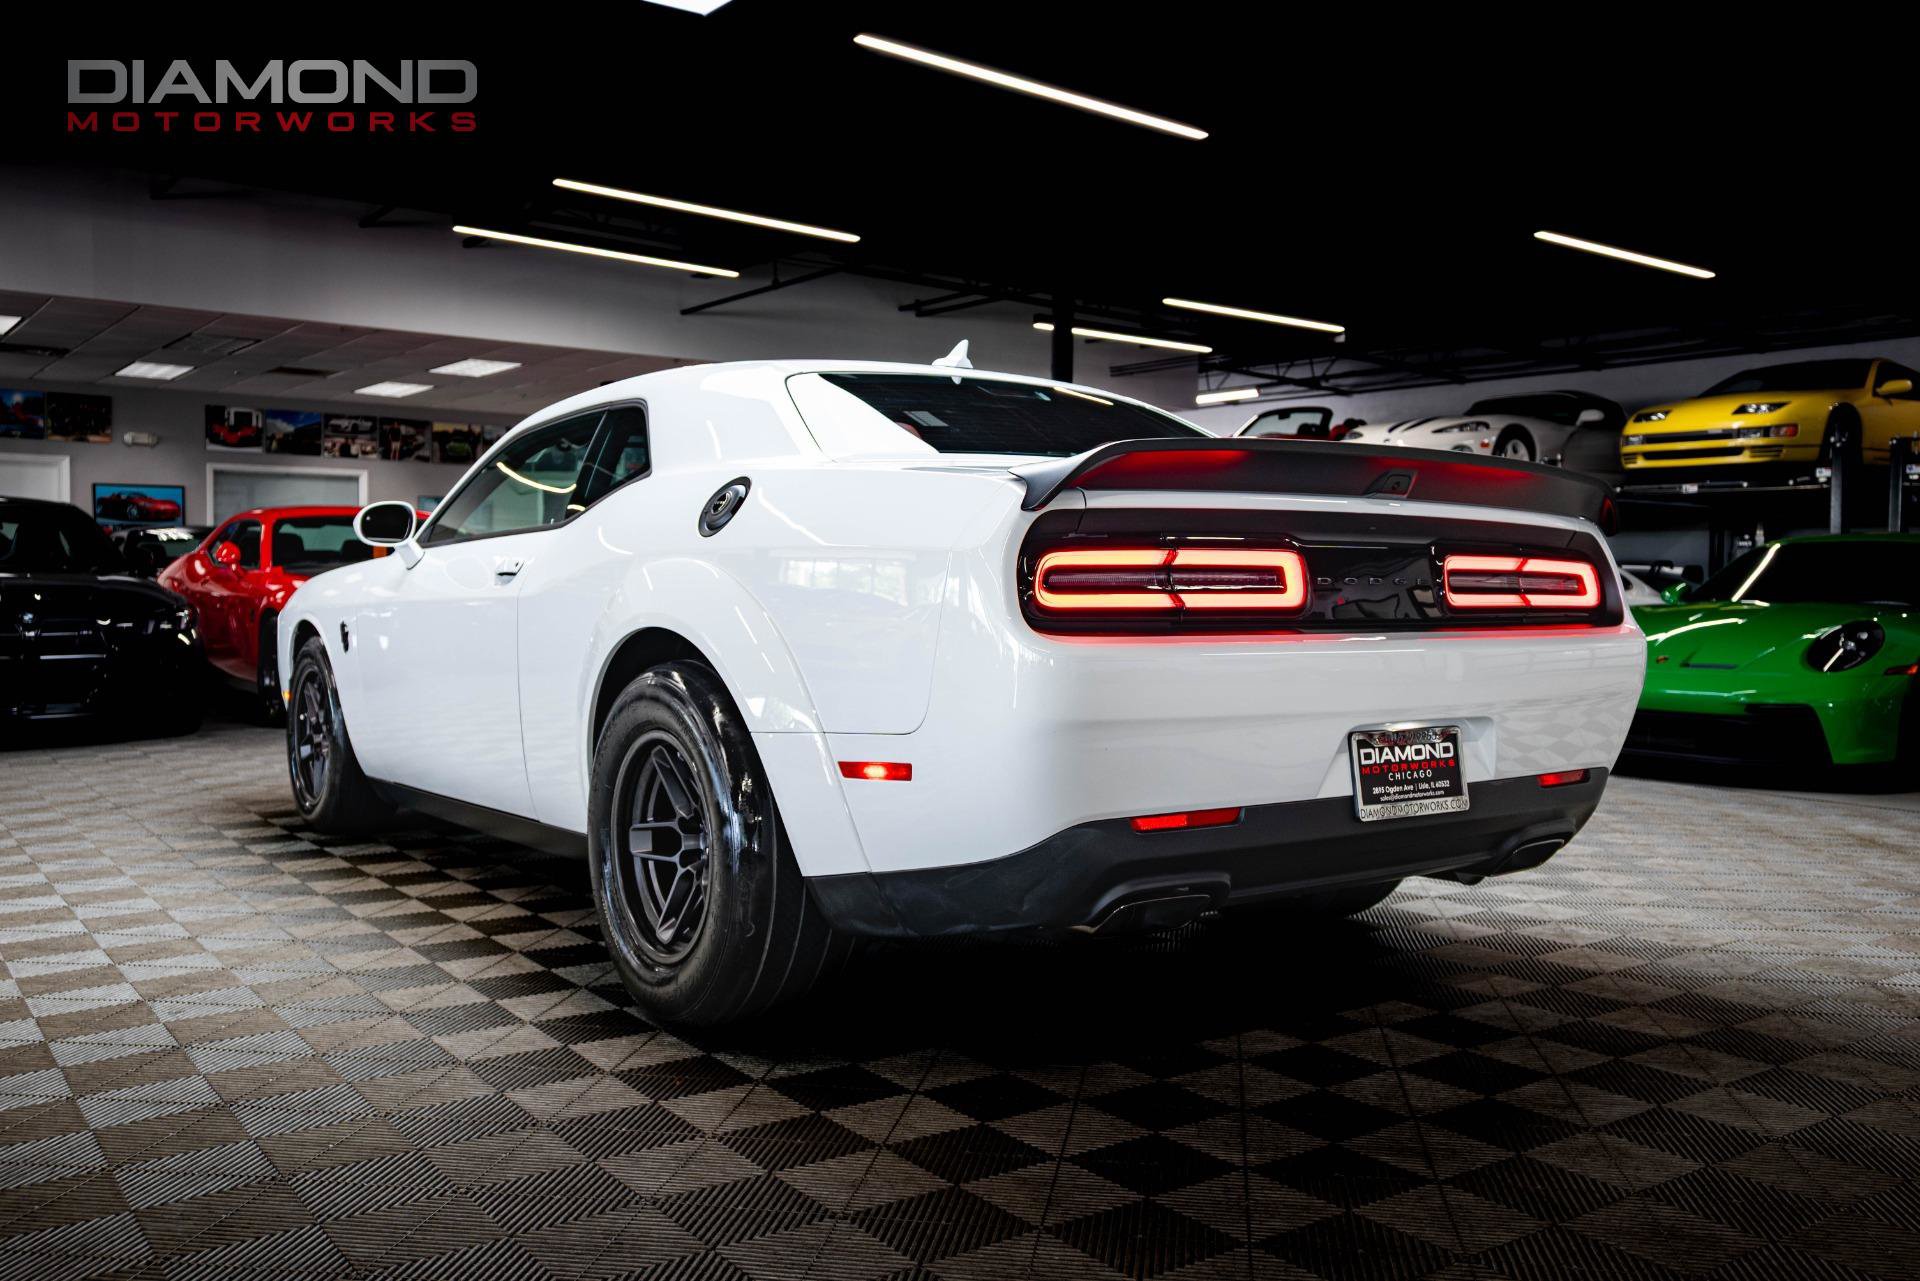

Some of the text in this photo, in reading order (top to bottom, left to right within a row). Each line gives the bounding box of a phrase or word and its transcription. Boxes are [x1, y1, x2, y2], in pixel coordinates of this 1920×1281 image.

[1360, 742, 1454, 765] DIAMOND
[1361, 759, 1456, 775] MOTORWORKS
[1388, 769, 1433, 781] CHICAGO
[1385, 784, 1403, 794] Ogden
